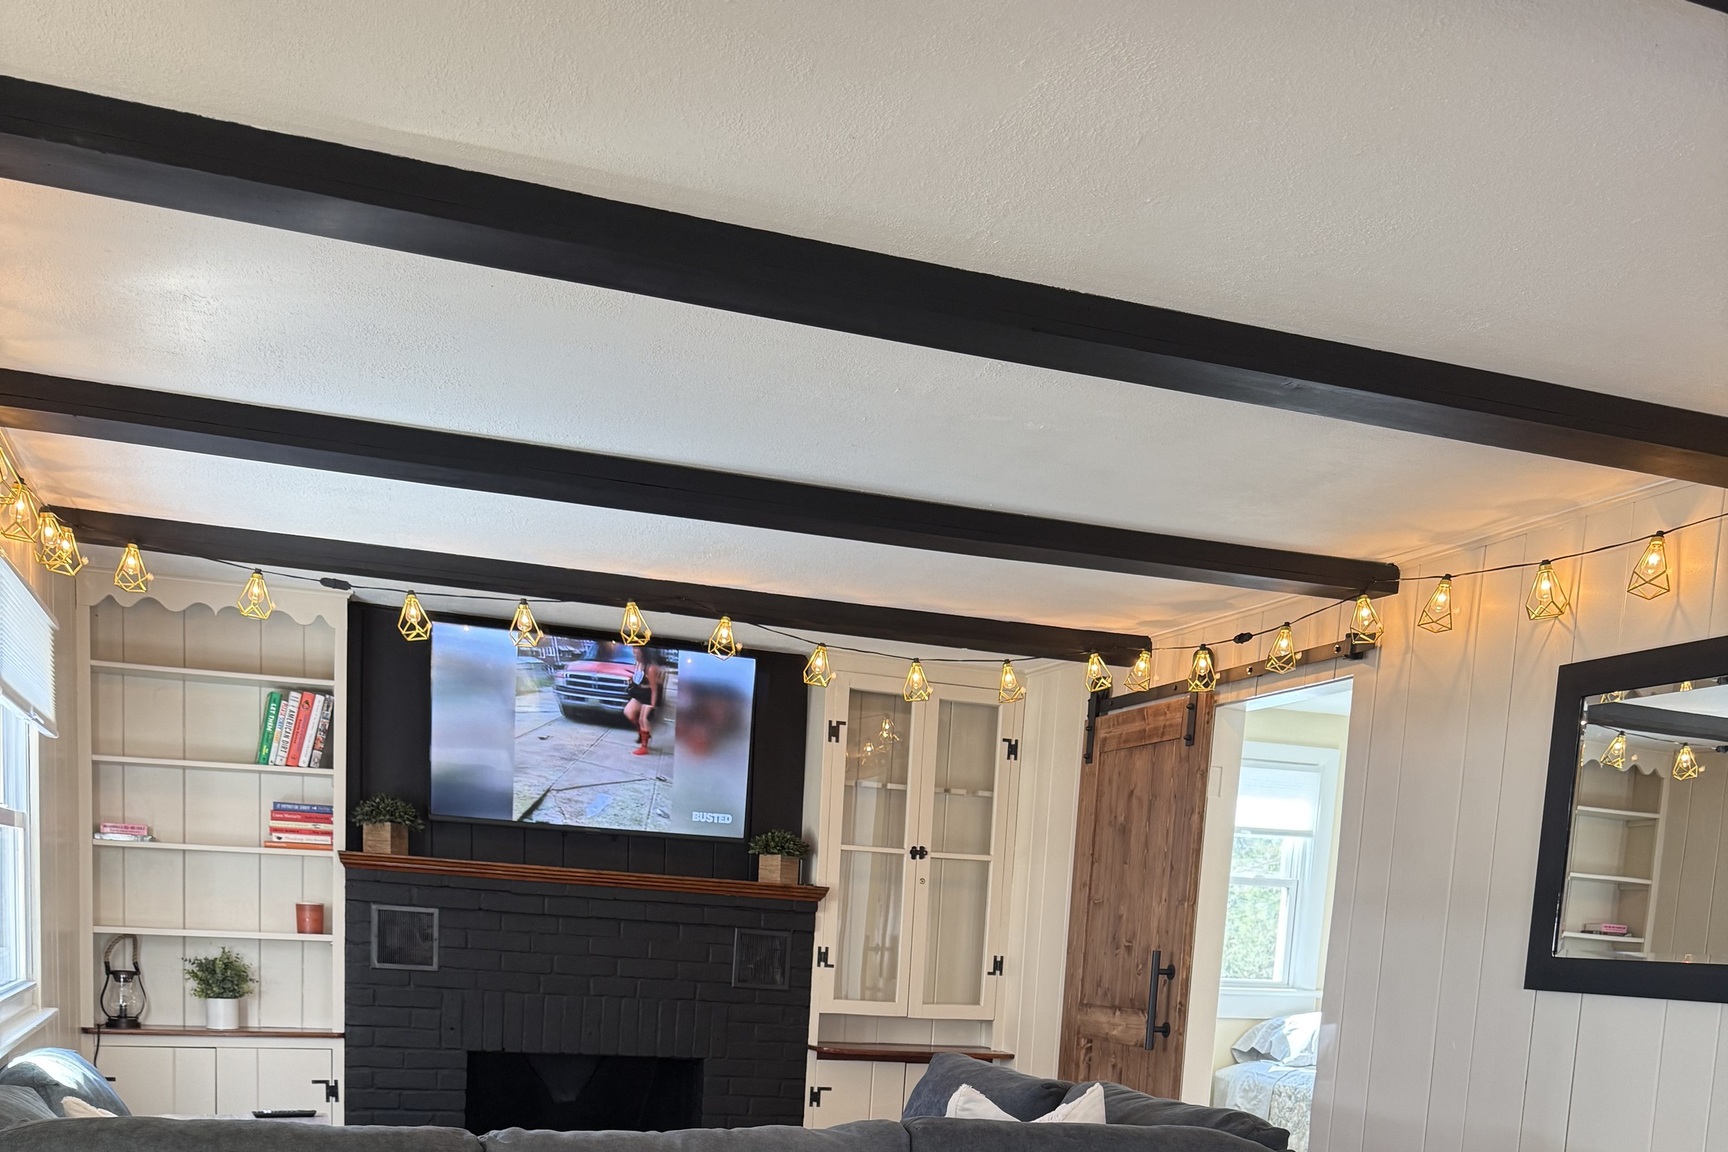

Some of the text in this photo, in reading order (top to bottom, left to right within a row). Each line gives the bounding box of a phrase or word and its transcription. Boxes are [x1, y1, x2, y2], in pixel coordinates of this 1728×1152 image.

[266, 703, 277, 732] LET THEM
[283, 709, 296, 739] AMERICAN
[280, 740, 290, 753] DIRT
[692, 811, 733, 824] BUSTED
